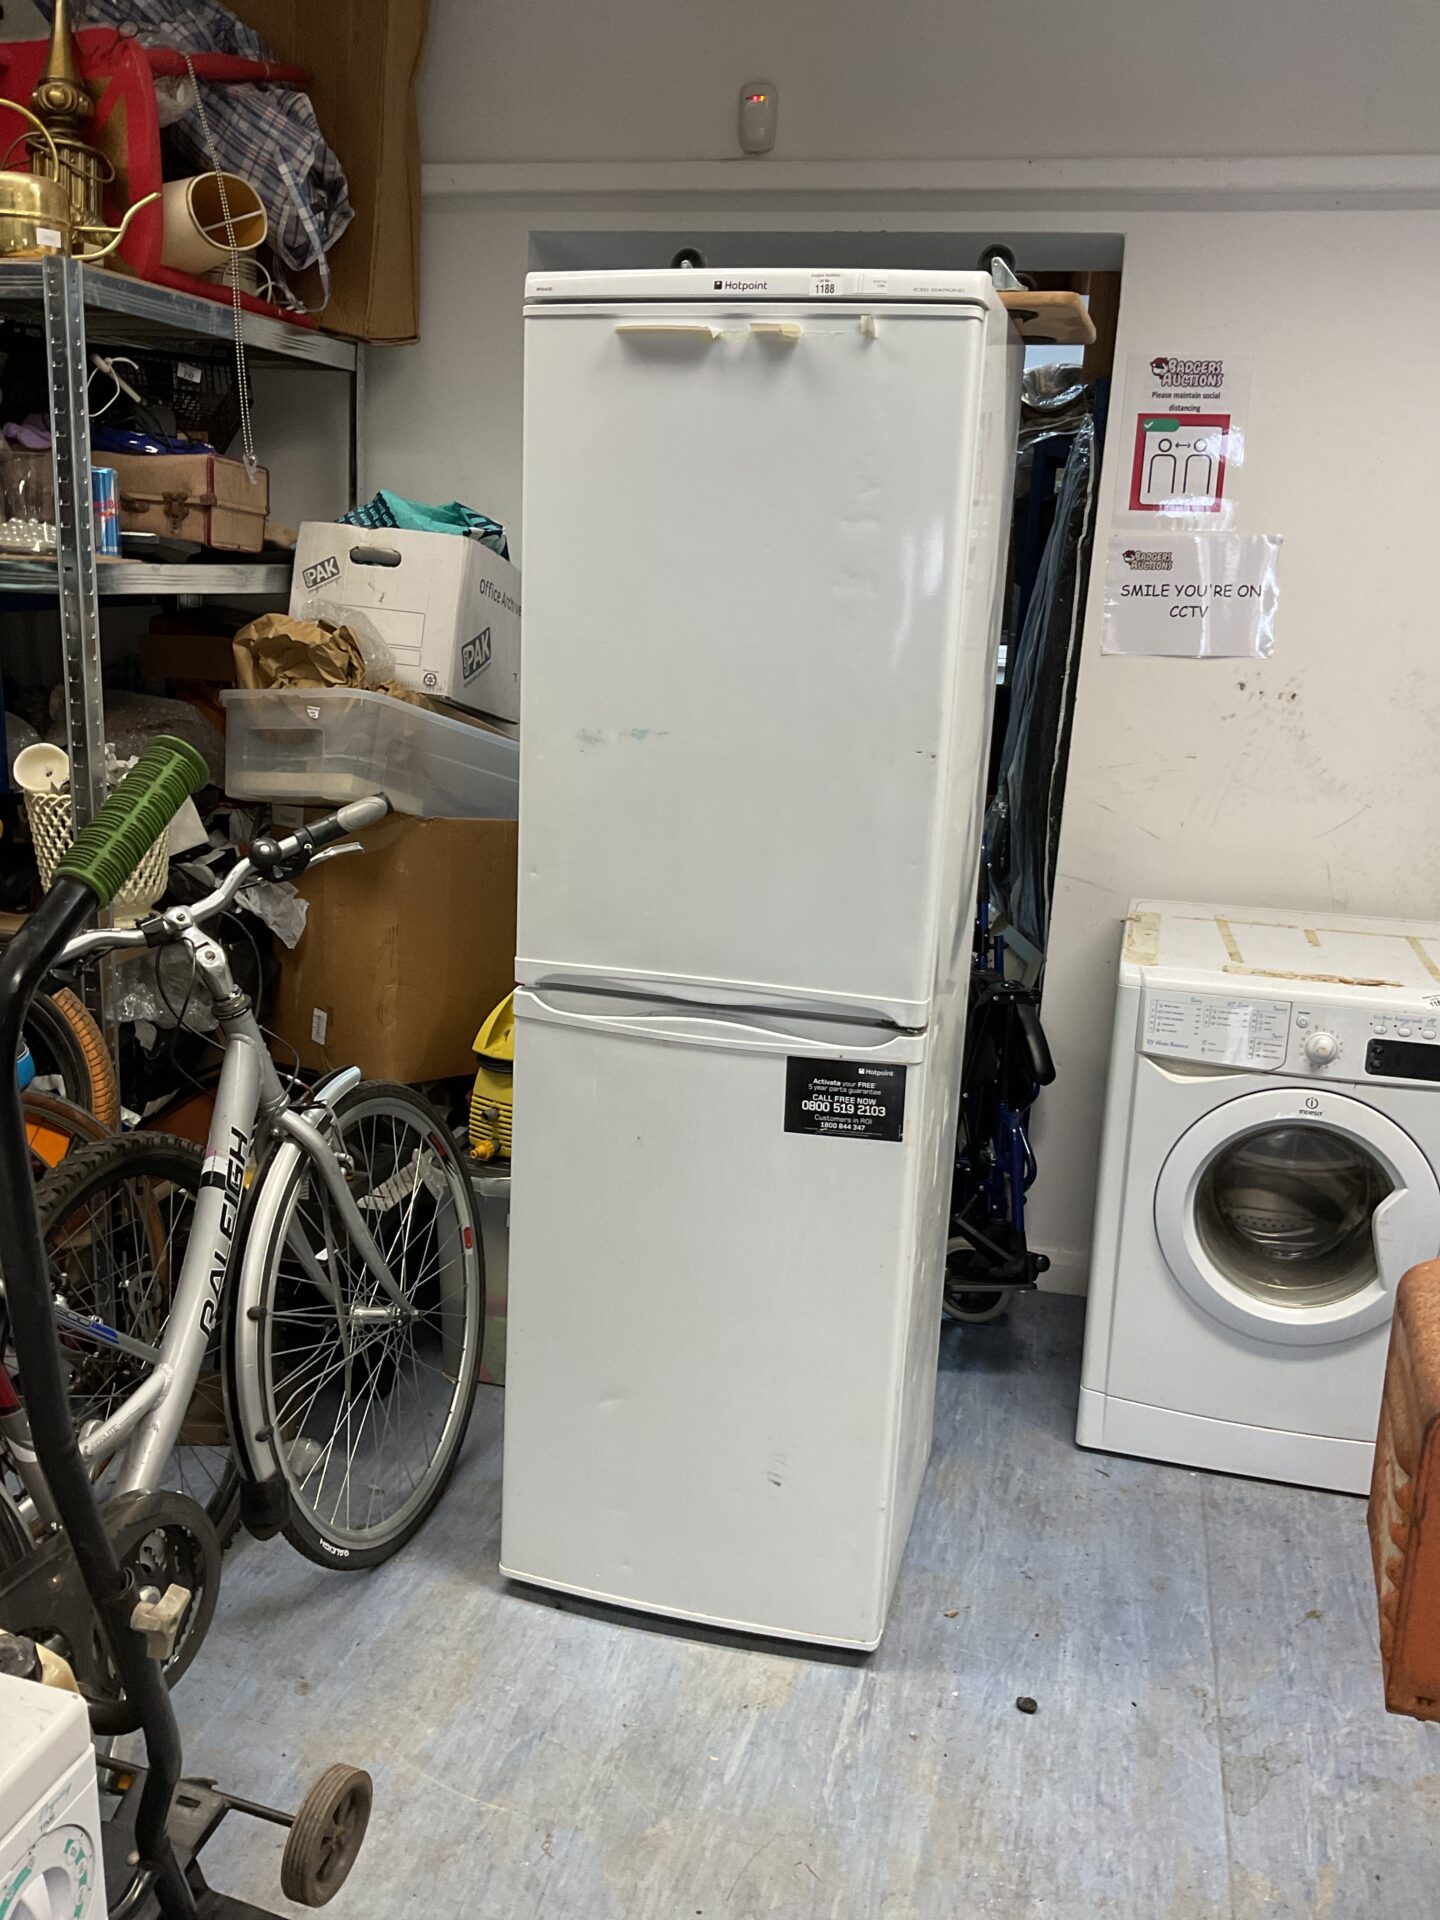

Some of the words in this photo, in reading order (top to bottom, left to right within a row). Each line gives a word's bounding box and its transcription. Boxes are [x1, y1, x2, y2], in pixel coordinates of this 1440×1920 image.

[725, 281, 768, 291] Hotpoint
[815, 283, 835, 294] 1188
[1168, 358, 1223, 374] BADGERS
[1161, 372, 1224, 388] AUCTIONS
[1152, 391, 1172, 399] Please
[1173, 391, 1201, 399] maintain
[1203, 391, 1221, 399] social
[1169, 404, 1201, 413] distancing
[1135, 551, 1172, 562] BADGERS
[1130, 560, 1173, 571] AUCTIONS
[303, 558, 339, 587] PAK
[480, 579, 501, 603] Office
[1120, 584, 1170, 597] SMILE
[1174, 584, 1233, 597] YOU'RE
[1237, 585, 1262, 597] ON
[1169, 605, 1209, 618] CCTV
[463, 629, 490, 677] PAK
[866, 1069, 894, 1077] Hotpoint
[813, 1078, 841, 1086] Activate
[848, 1088, 881, 1096] guarantee
[812, 1094, 833, 1102] CALL
[834, 1095, 856, 1104] FREE
[856, 1097, 877, 1105] NOW
[801, 1100, 830, 1112] 0800
[833, 1102, 855, 1114] 519
[857, 1105, 886, 1117] 2103
[814, 1114, 851, 1123] Customers
[820, 1121, 838, 1129] 1800
[199, 1126, 248, 1337] RALEIGH
[319, 1538, 350, 1557] RALEIGH
